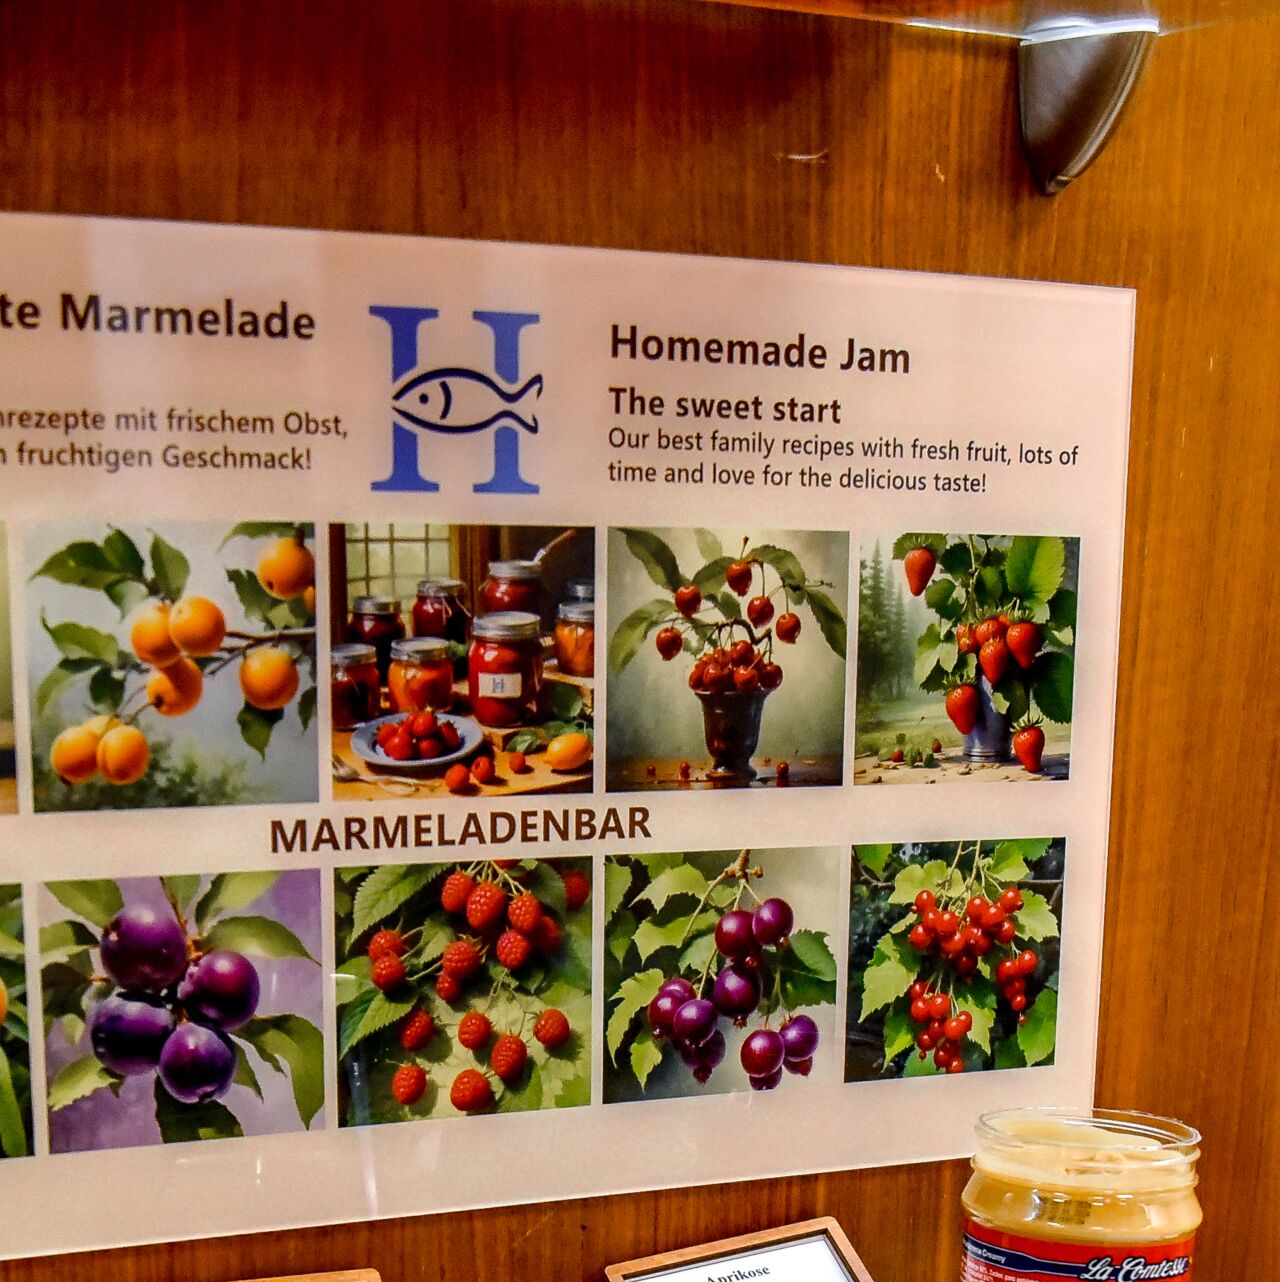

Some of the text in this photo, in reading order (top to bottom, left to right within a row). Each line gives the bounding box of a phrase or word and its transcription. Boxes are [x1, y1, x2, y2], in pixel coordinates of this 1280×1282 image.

[60, 292, 316, 341] Marmelade
[610, 324, 910, 374] Homemade Jam
[114, 406, 158, 432] mit
[166, 407, 275, 435] frischem
[283, 411, 348, 440] Obst,
[607, 385, 842, 425] The sweet start
[16, 440, 153, 474] fruchtigen
[161, 444, 311, 471] Geschmack!
[608, 426, 1079, 466] Our best family recipes with fresh fruit, lots of
[607, 459, 986, 493] time and love for the delicious taste!
[270, 806, 652, 854] MARMELADENBAR
[1080, 1257, 1114, 1281] La
